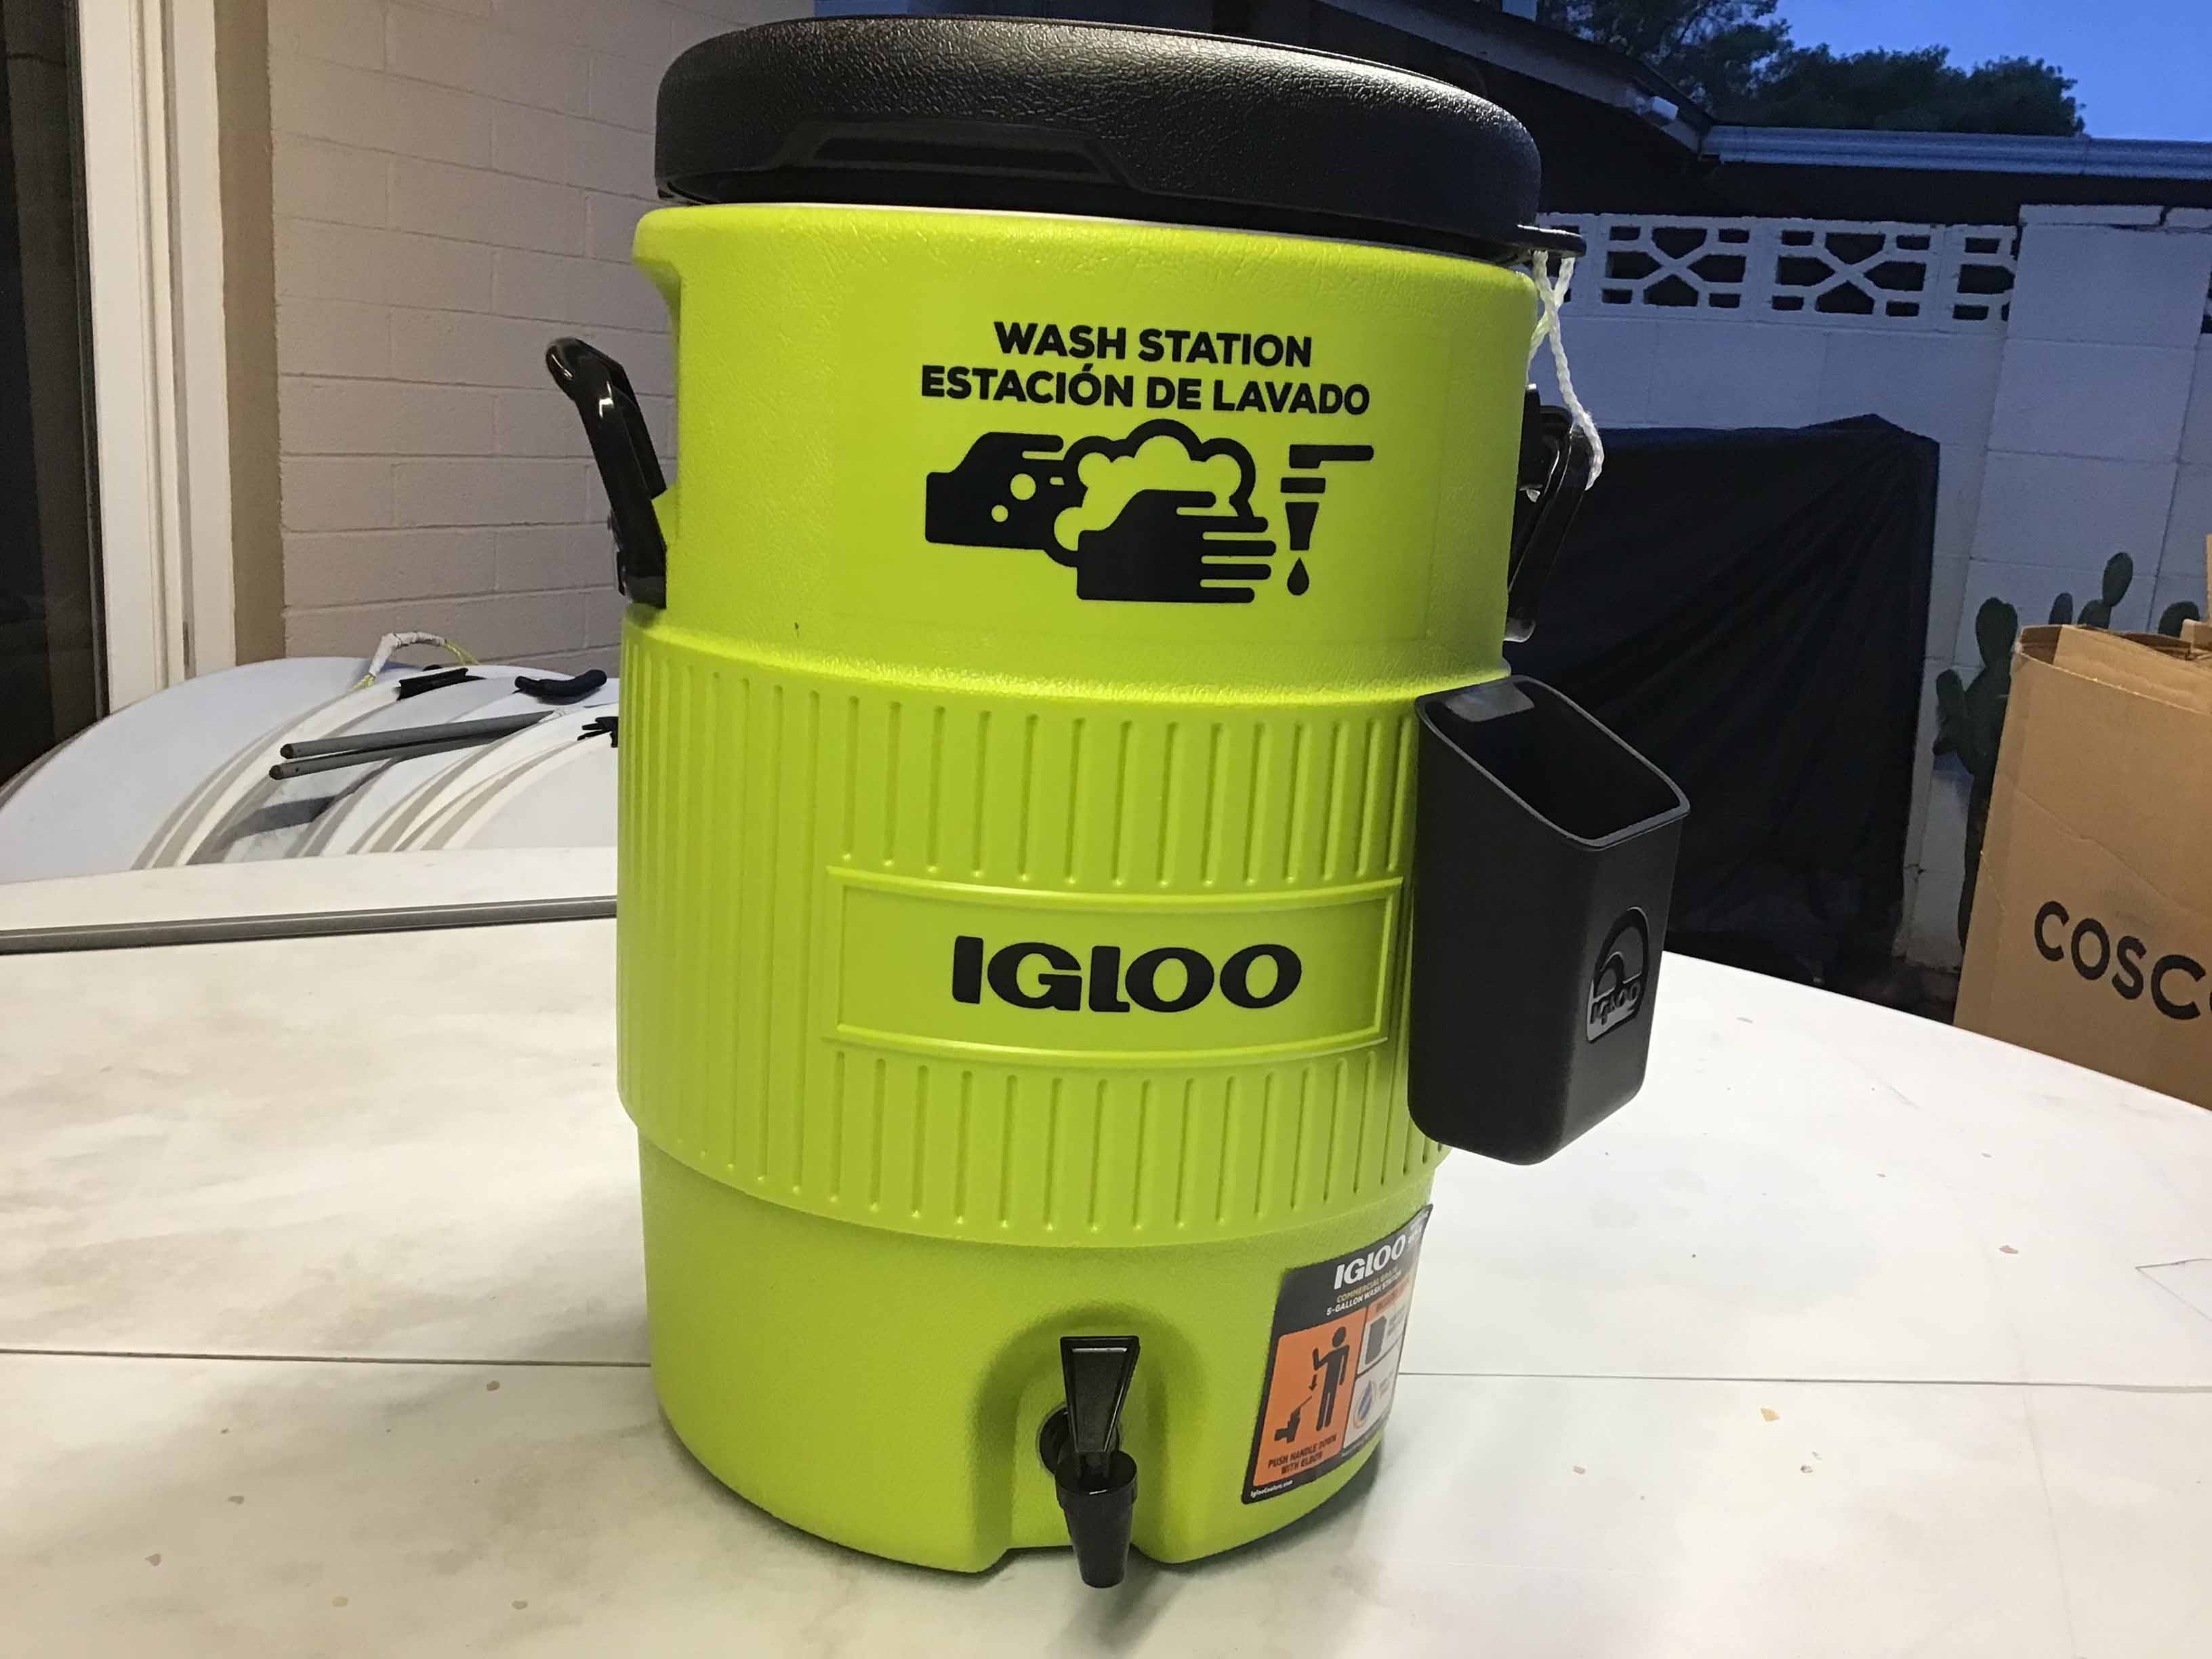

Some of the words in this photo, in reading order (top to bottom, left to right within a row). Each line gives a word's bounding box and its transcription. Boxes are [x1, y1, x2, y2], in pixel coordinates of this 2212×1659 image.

[994, 321, 1126, 360] WASH
[1138, 328, 1312, 367] STATION
[922, 363, 1134, 407] ESTACIÓN
[1146, 376, 1202, 410] DE
[1213, 379, 1370, 415] LAVADO
[951, 935, 1303, 1013] IGLOO
[2034, 900, 2212, 1021] COSC
[1334, 1234, 1406, 1290] IGLOO
[1326, 1294, 1363, 1315] 5-GALLON
[1364, 1284, 1382, 1300] WASH
[1268, 1455, 1288, 1468] PUSH
[1288, 1443, 1317, 1462] HANDLE
